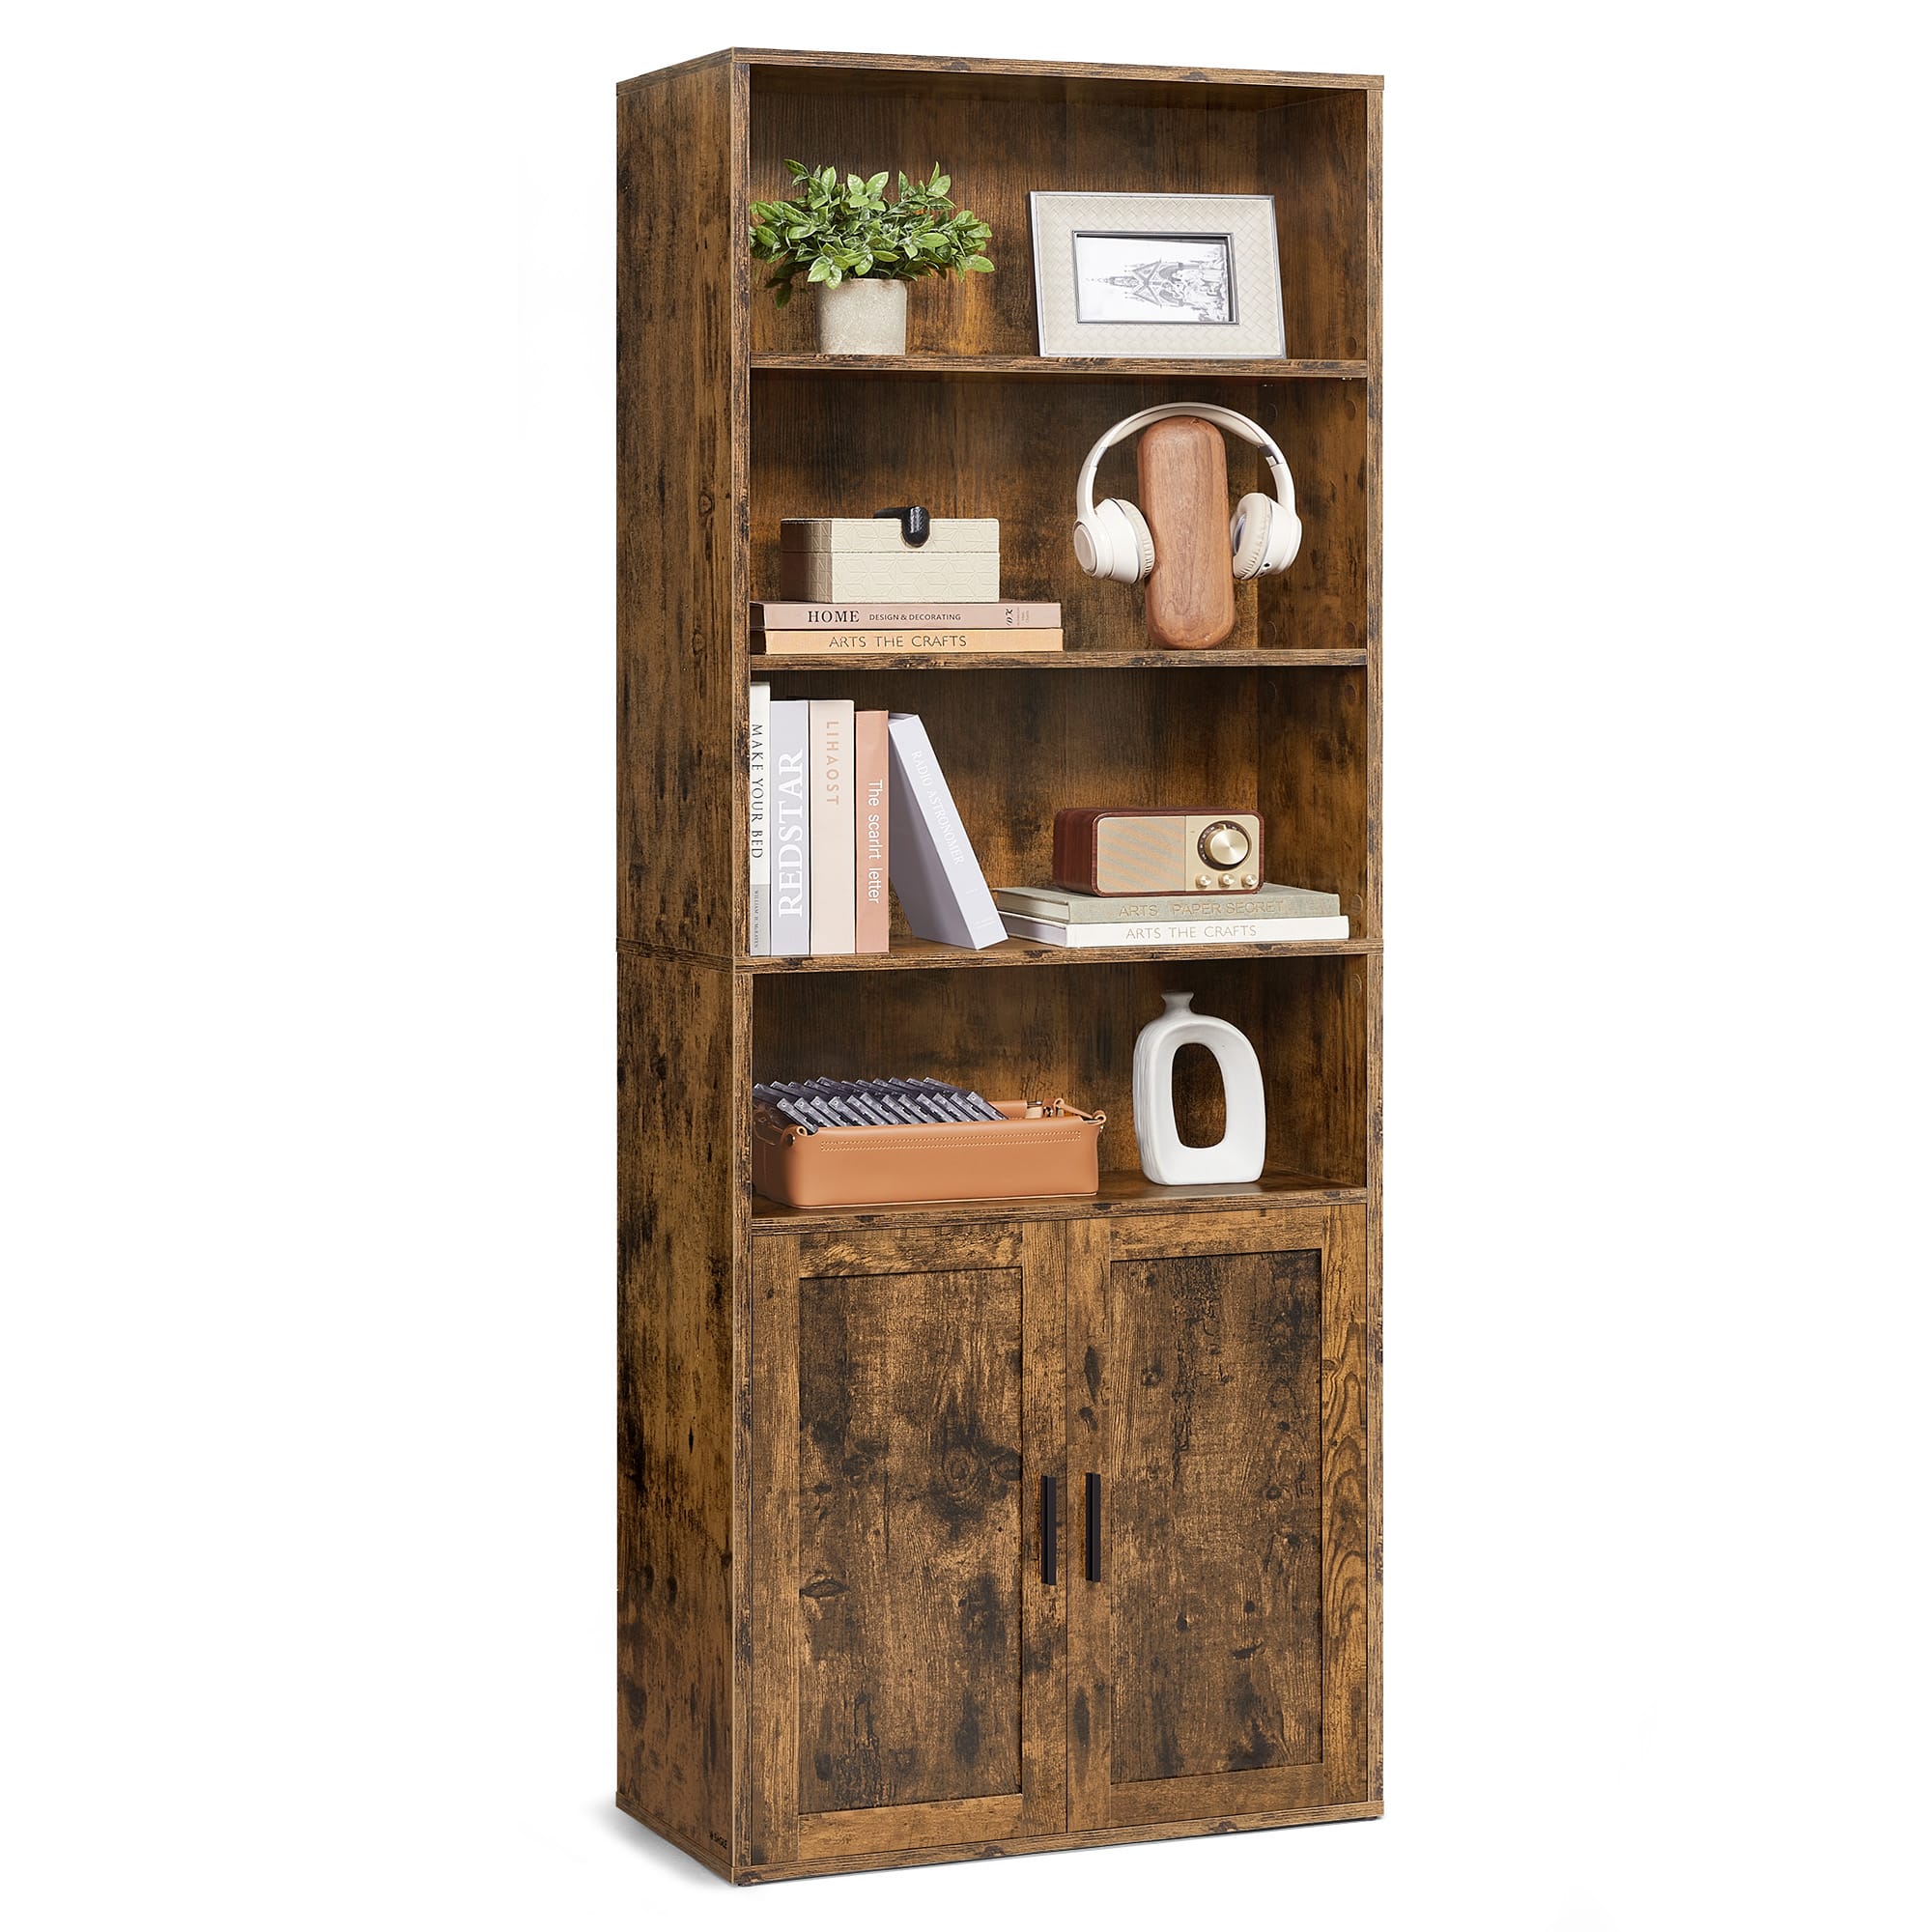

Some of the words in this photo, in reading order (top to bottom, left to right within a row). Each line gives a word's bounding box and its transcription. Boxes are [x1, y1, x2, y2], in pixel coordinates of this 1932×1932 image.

[808, 610, 860, 623] HOME
[828, 636, 867, 648] ARTS
[873, 636, 904, 648] THE
[911, 635, 967, 647] CRAFTS
[752, 724, 764, 771] MAKE
[826, 721, 839, 806] LIHAOST
[752, 778, 764, 823] YOUR
[867, 779, 883, 807] The
[912, 751, 933, 787] RADIO
[927, 789, 965, 866] ASTRONOMER
[752, 830, 764, 859] BED
[779, 750, 804, 918] REDSTAR
[867, 813, 884, 860] scarlrt
[867, 867, 884, 904] letter
[1119, 904, 1158, 917] ARTS
[1171, 903, 1222, 915] PAPER
[1226, 900, 1284, 914] SECRET
[1125, 927, 1161, 939] ARTS
[1168, 926, 1197, 938] THE
[1204, 924, 1257, 937] CRAFTS
